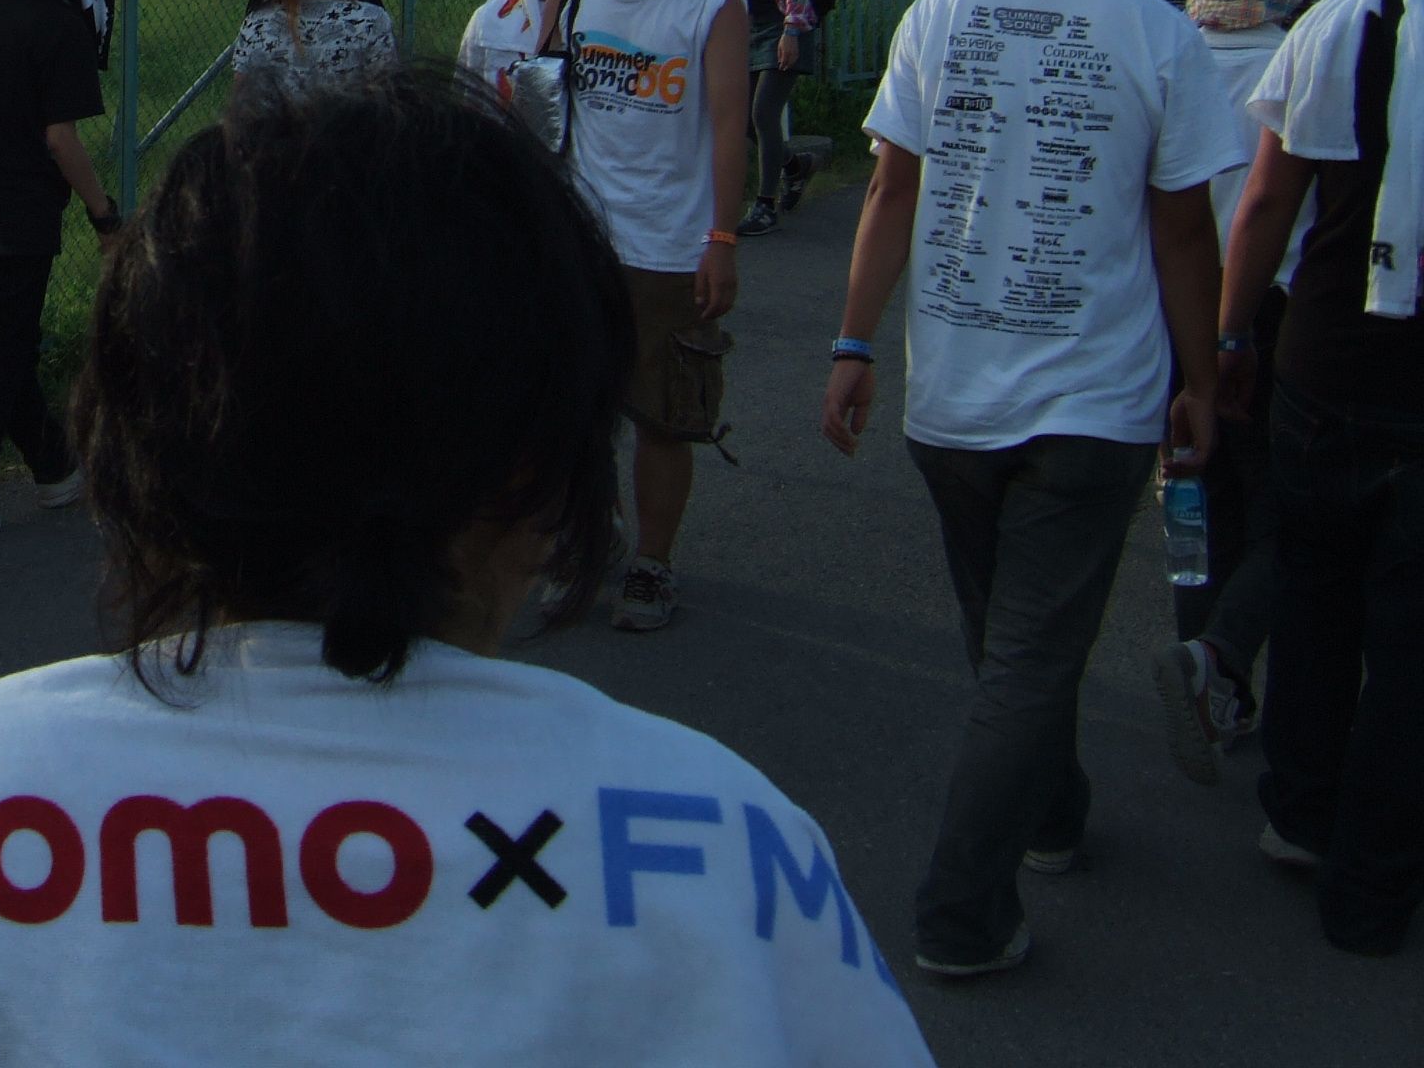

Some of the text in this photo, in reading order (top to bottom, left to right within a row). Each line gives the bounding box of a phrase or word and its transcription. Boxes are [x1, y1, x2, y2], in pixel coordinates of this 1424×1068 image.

[995, 9, 1064, 26] SUMMER
[1001, 19, 1054, 33] SONIC
[572, 31, 657, 71] Summer
[1043, 44, 1110, 63] COLDPLAY
[1038, 58, 1113, 72] ALICIA KEYS
[572, 62, 639, 97] Sonic
